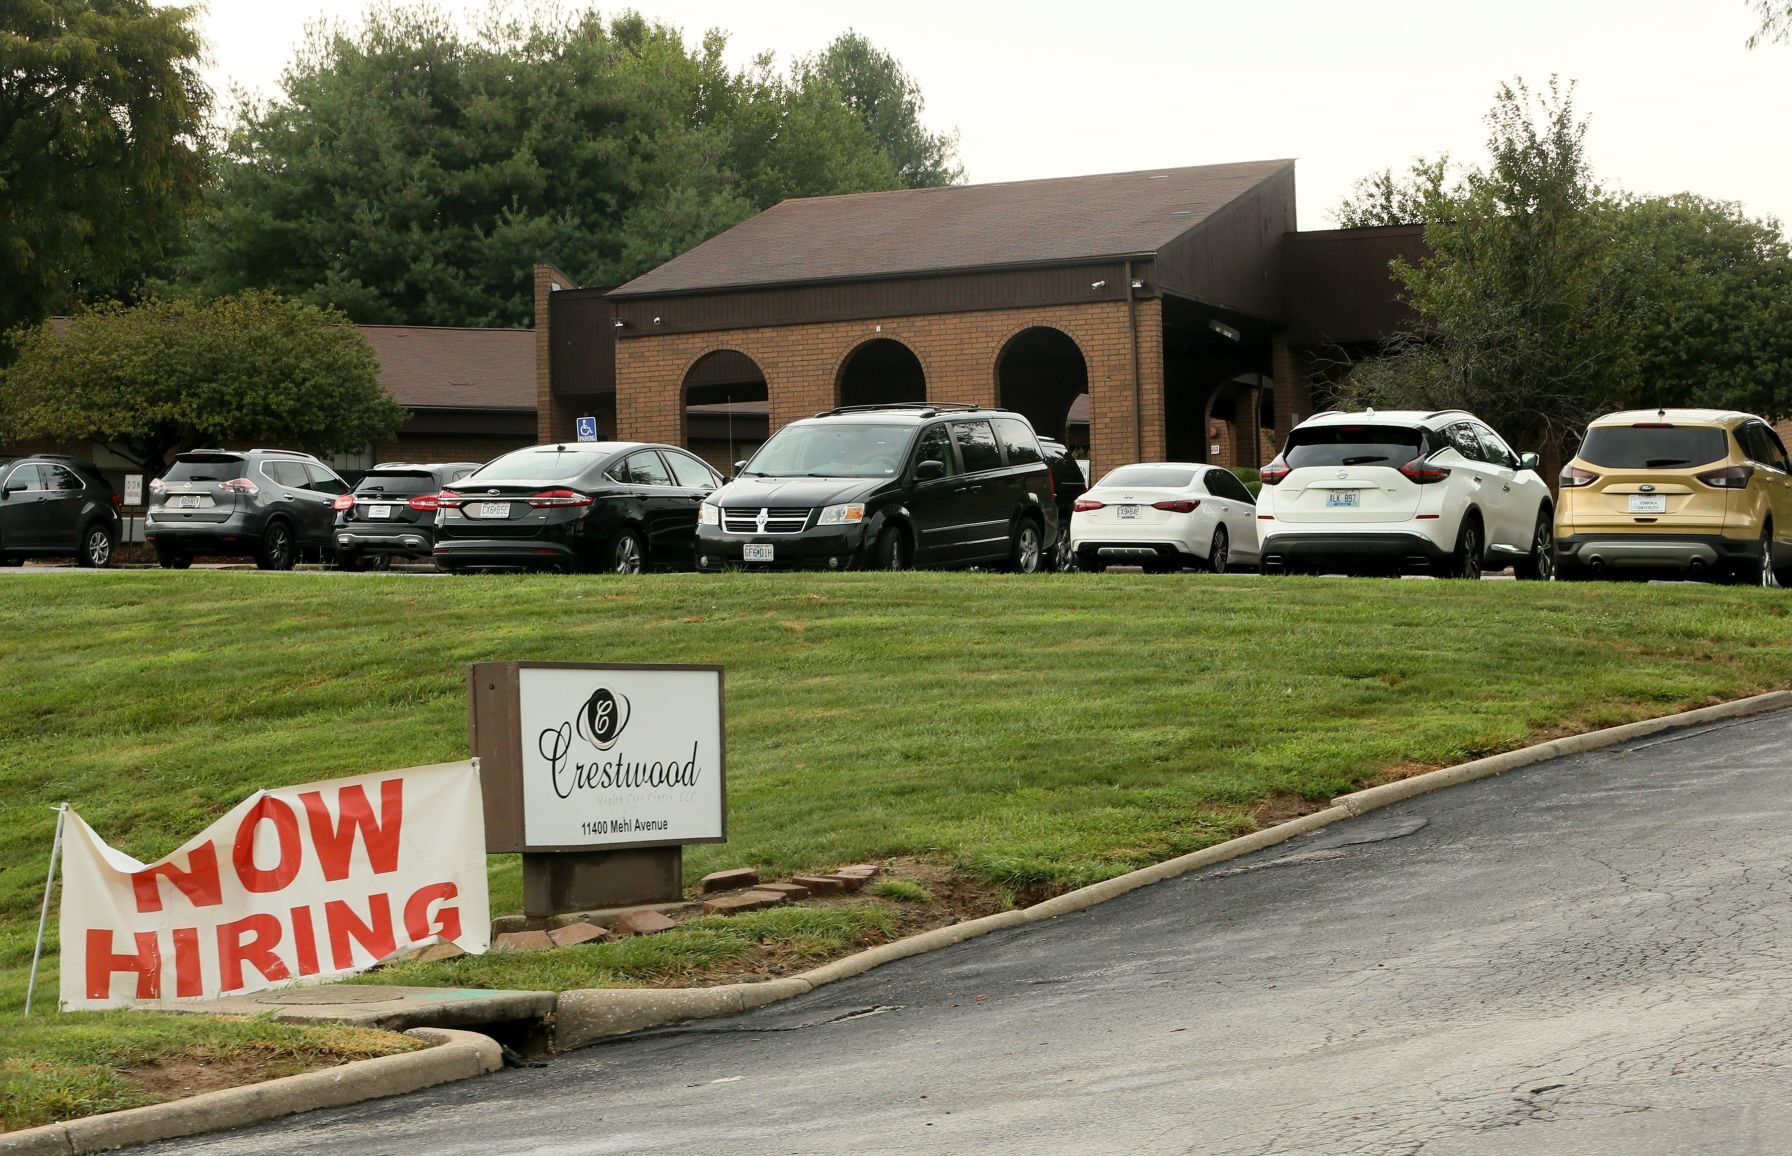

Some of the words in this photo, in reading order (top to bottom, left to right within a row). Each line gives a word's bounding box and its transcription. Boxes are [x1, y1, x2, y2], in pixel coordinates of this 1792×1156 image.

[538, 721, 702, 799] Crestwood
[131, 778, 404, 914] NOW
[581, 820, 608, 836] 11400
[610, 819, 632, 834] Mehl
[634, 818, 668, 832] Avenue
[85, 881, 462, 999] HIRING
